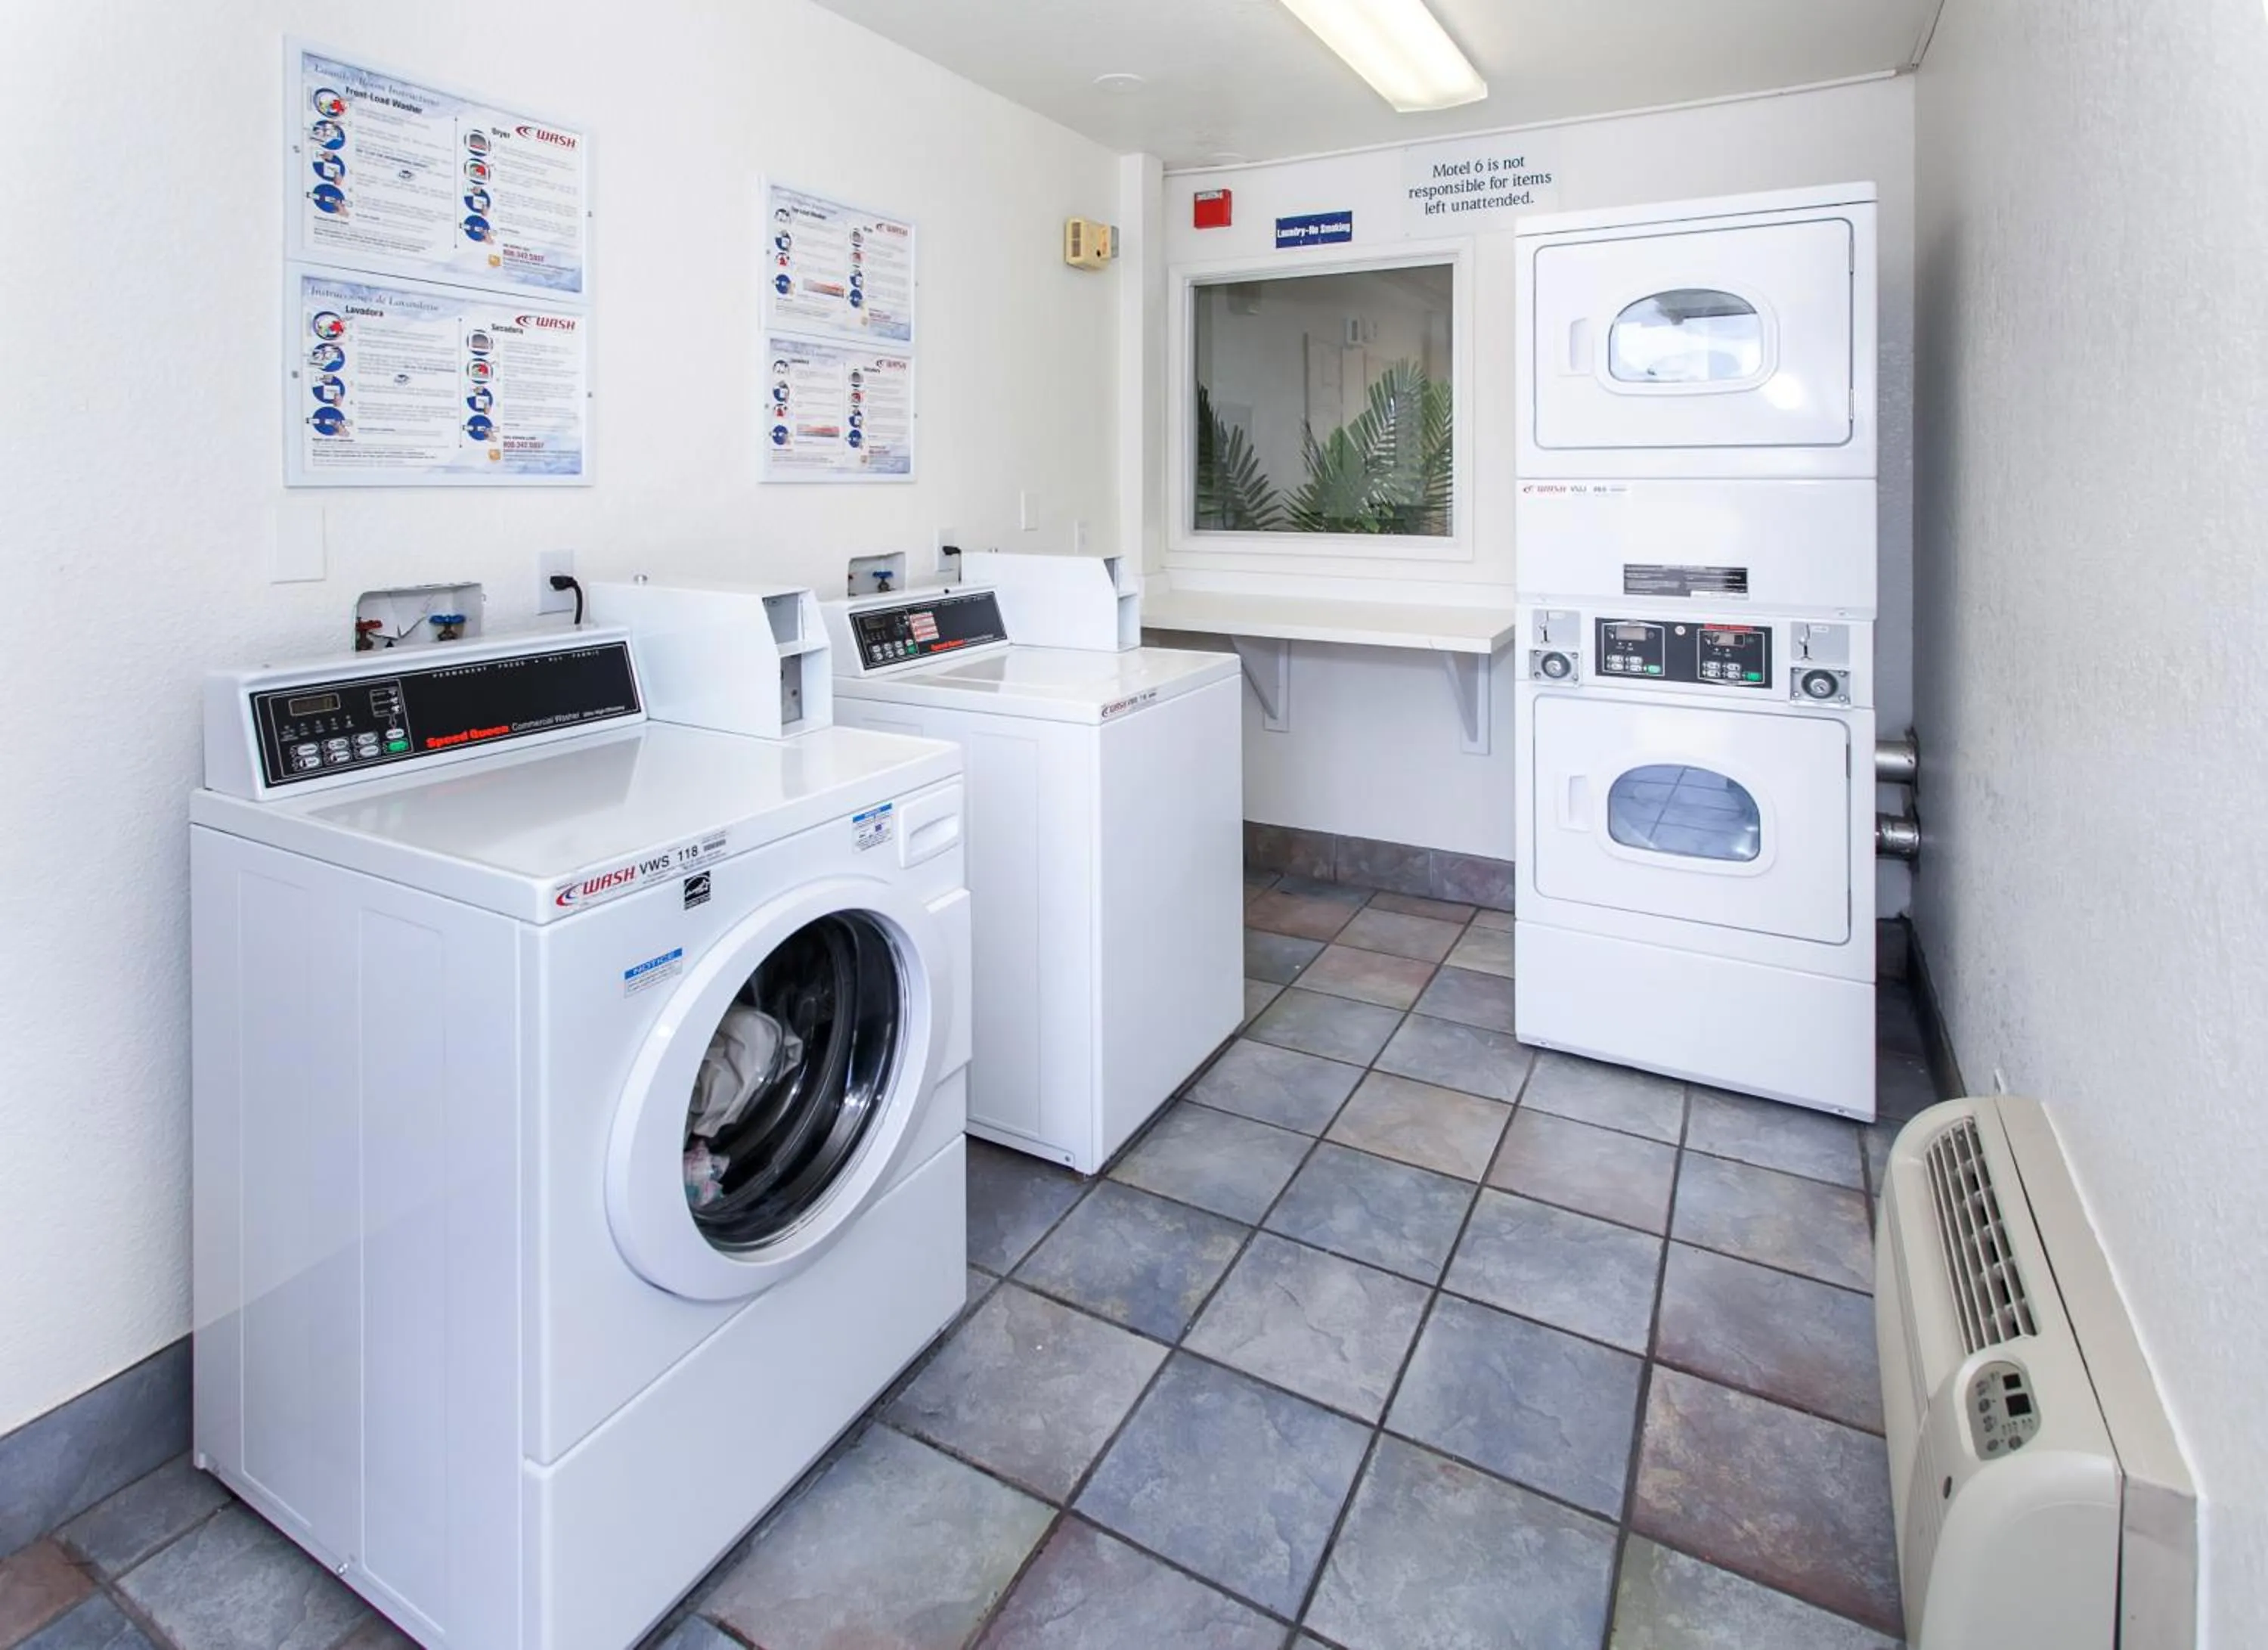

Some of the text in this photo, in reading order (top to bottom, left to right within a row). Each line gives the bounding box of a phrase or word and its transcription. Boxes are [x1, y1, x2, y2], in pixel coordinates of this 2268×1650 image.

[345, 86, 423, 113] Front-Load Washer
[536, 129, 576, 148] WASH
[1433, 157, 1525, 178] Motel 6 is not
[1408, 172, 1552, 200] responsible for items
[1425, 191, 1535, 216] left unattended.
[1320, 222, 1350, 234] Smoking
[345, 305, 384, 317] Lavadora
[491, 323, 524, 335] Secadora
[536, 316, 576, 330] WASH
[426, 730, 468, 749] Speed
[469, 724, 509, 740] Queen
[583, 845, 699, 895] WASH VWS 118
